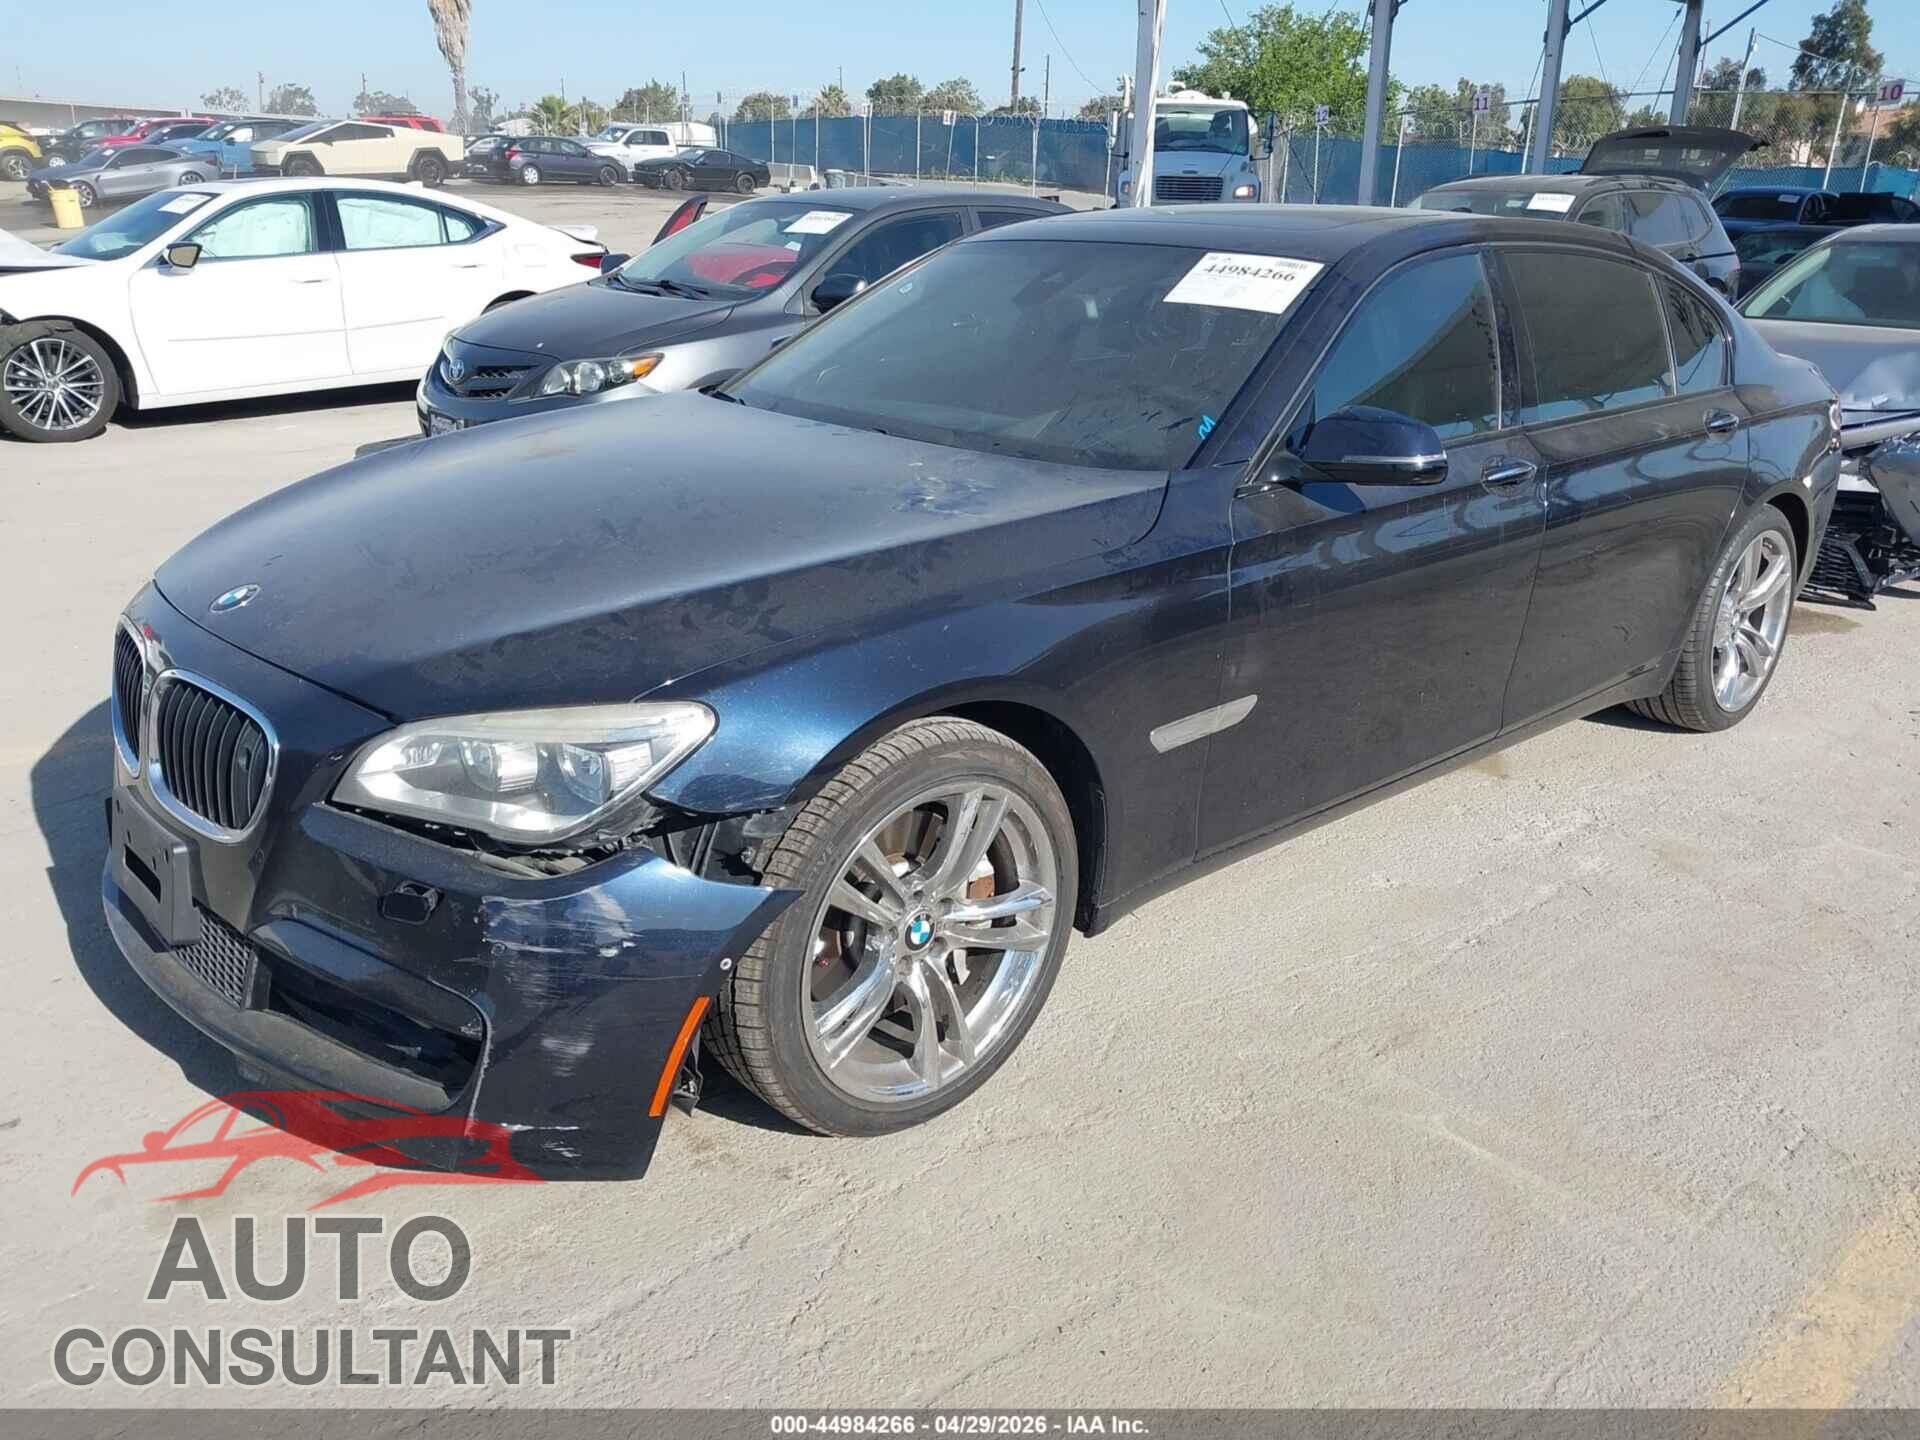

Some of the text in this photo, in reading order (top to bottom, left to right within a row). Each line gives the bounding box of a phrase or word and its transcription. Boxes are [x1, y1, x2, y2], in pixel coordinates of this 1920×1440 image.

[1878, 84, 1903, 101] 10
[1474, 96, 1489, 110] 11
[1203, 263, 1296, 282] 44984266
